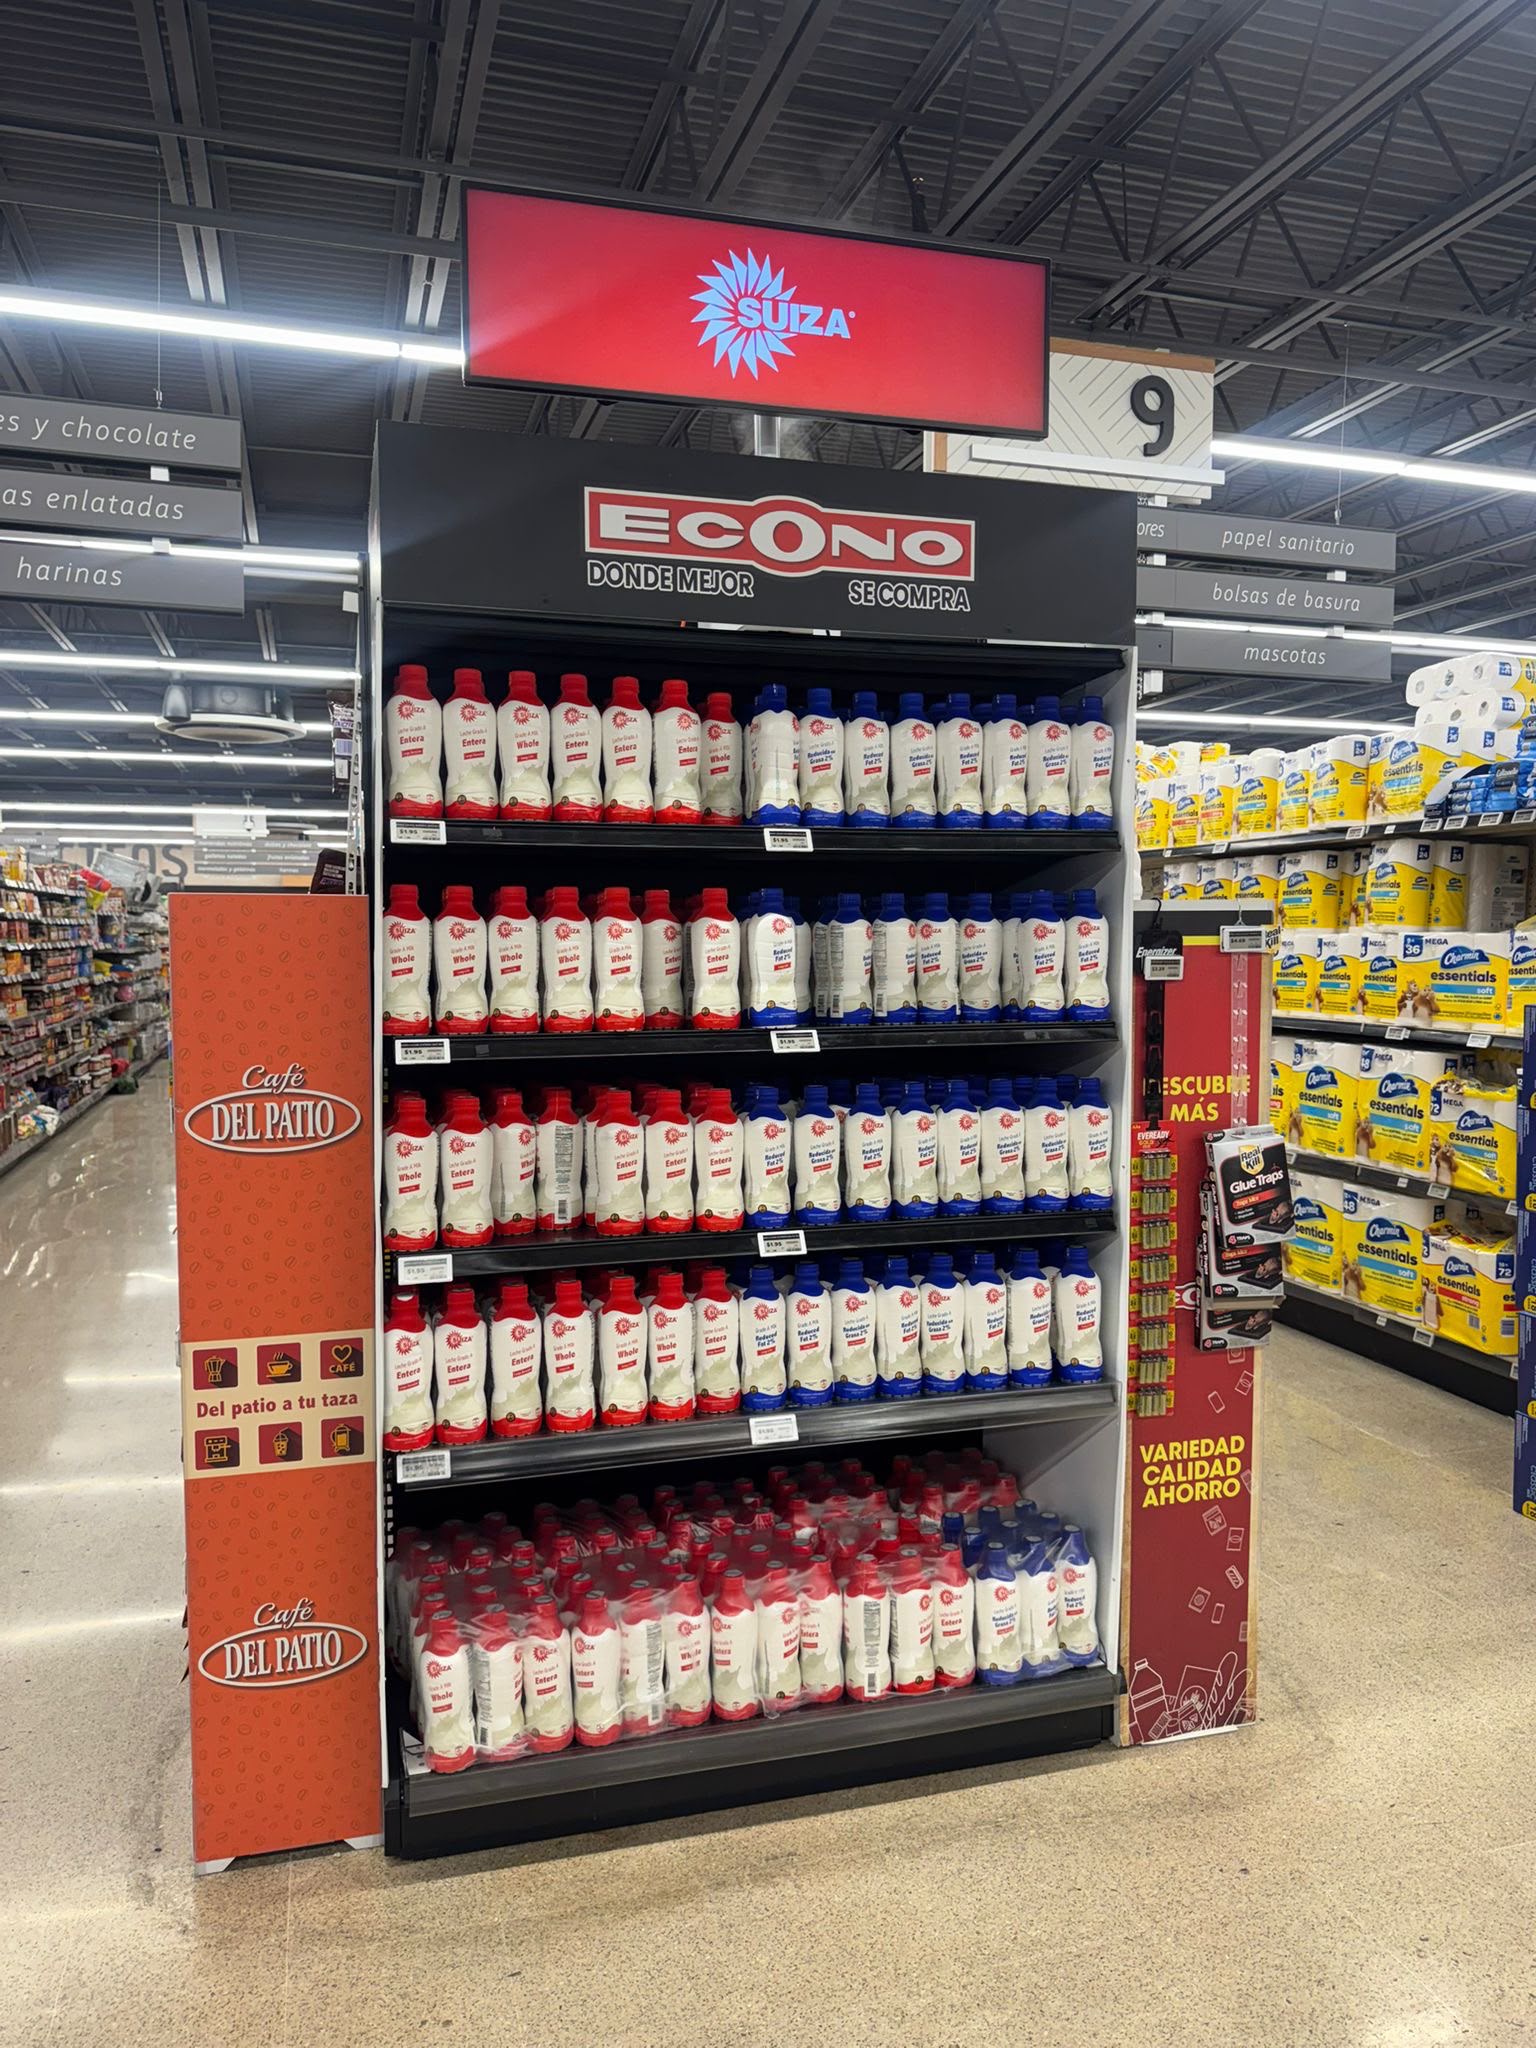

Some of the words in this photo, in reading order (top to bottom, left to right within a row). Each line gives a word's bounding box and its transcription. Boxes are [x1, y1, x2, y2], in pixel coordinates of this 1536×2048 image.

[737, 296, 851, 339] SUIZA
[1130, 375, 1174, 457] 9
[31, 417, 49, 440] y
[62, 416, 196, 449] chocolate
[46, 490, 184, 520] enlatadas
[600, 503, 963, 566] ECONO
[1222, 529, 1272, 550] papel
[1278, 533, 1354, 556] sanitario
[17, 556, 122, 586] harinas
[587, 560, 673, 591] DONDE
[677, 566, 754, 598] MEJOR
[849, 580, 875, 606] SE
[877, 582, 971, 612] COMPRA
[1213, 582, 1268, 606] bolsas
[1276, 587, 1296, 607] de
[1303, 589, 1361, 612] basura
[1244, 645, 1327, 665] mascotas
[400, 735, 424, 745] Entera
[462, 738, 486, 747] Entera
[517, 740, 539, 749] Whole
[565, 741, 588, 749] Entera
[614, 744, 637, 753] Entera
[711, 754, 730, 763] Whole
[1283, 888, 1312, 896] essentials
[1405, 945, 1420, 954] 36
[391, 955, 415, 965] Whole
[453, 954, 476, 964] Whole
[500, 953, 523, 963] Whole
[558, 954, 579, 964] Whole
[611, 954, 632, 963] Whole
[707, 954, 729, 963] Entera
[1444, 951, 1479, 965] Charmin
[1320, 971, 1351, 980] essentials
[1431, 971, 1496, 983] essentials
[1476, 986, 1493, 994] soft
[242, 1062, 305, 1094] Café
[1381, 1081, 1410, 1093] Charmin
[1299, 1090, 1343, 1107] essentials
[1443, 1098, 1463, 1107] MEGA
[1170, 1097, 1219, 1122] MÁS
[1370, 1099, 1424, 1119] essentials
[211, 1103, 260, 1140] DEL
[264, 1100, 335, 1139] PATIO
[1137, 1130, 1170, 1141] EVEREADY
[1449, 1131, 1498, 1148] essentials
[1241, 1145, 1261, 1162] Real
[616, 1159, 638, 1169] Entera
[665, 1157, 687, 1167] Entera
[710, 1157, 732, 1166] Entera
[1246, 1156, 1260, 1169] Kill
[398, 1172, 422, 1182] Whole
[451, 1168, 475, 1178] Entera
[1230, 1179, 1256, 1193] Glue
[1256, 1170, 1284, 1186] Traps
[1360, 1196, 1380, 1206] MEGA
[1370, 1224, 1400, 1238] Charmin
[1228, 1235, 1236, 1244] 4
[1357, 1242, 1418, 1266] essentials
[1398, 1268, 1413, 1278] soft
[1498, 1268, 1512, 1276] 72
[1438, 1276, 1480, 1296] essentials
[705, 1335, 727, 1344] Entera
[656, 1342, 677, 1351] Whole
[554, 1351, 576, 1362] Whole
[618, 1348, 639, 1358] Whole
[512, 1354, 534, 1366] Entera
[328, 1362, 356, 1374] CAFÉ
[396, 1367, 421, 1380] Entera
[448, 1363, 471, 1373] Entera
[197, 1401, 224, 1418] Del
[232, 1398, 276, 1419] patio
[282, 1400, 292, 1411] a
[298, 1396, 315, 1409] tu
[321, 1393, 358, 1408] taza
[1140, 1435, 1245, 1464] VARIEDAD
[1142, 1456, 1241, 1486] CALIDAD
[1142, 1477, 1241, 1508] AHORRO
[253, 1597, 313, 1629] Café
[941, 1618, 962, 1627] Entera
[224, 1639, 271, 1679] DEL
[275, 1630, 342, 1673] PATIO
[535, 1674, 558, 1685] Entera
[431, 1691, 453, 1702] Whole
